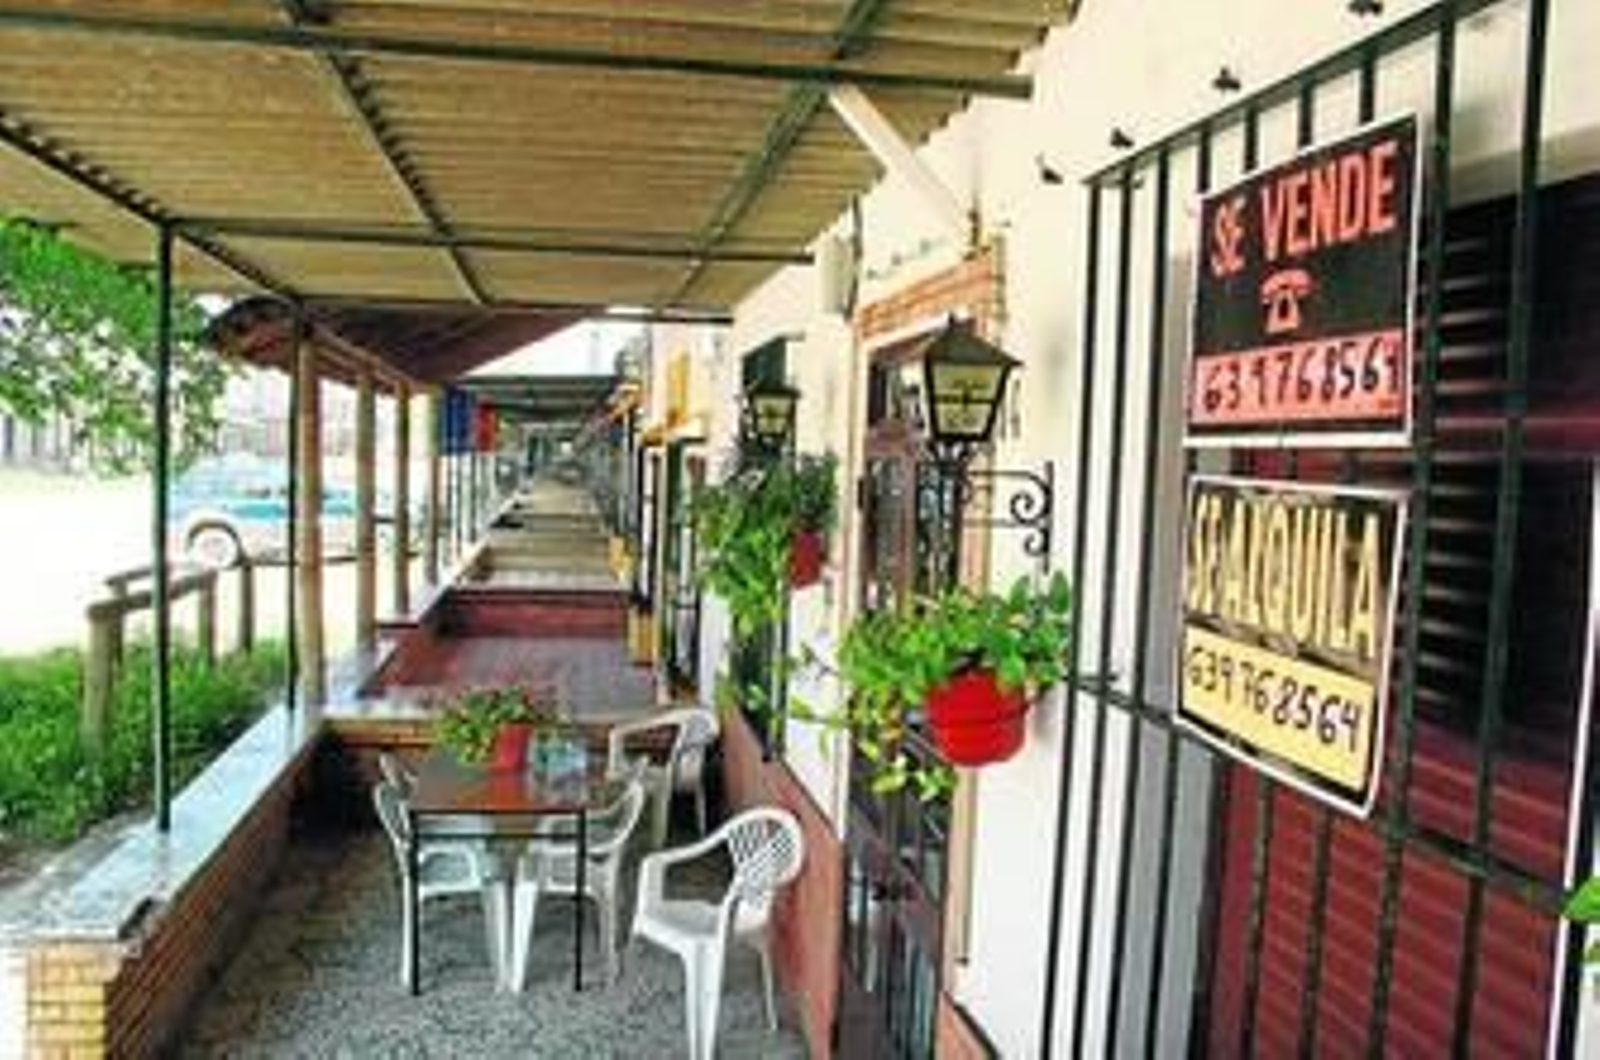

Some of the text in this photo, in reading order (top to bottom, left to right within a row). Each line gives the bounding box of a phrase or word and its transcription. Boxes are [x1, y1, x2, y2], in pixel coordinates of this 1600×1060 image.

[1210, 139, 1399, 277] SE VENDE
[1221, 498, 1380, 660] ALQUILA
[1186, 646, 1362, 754] 639768564
